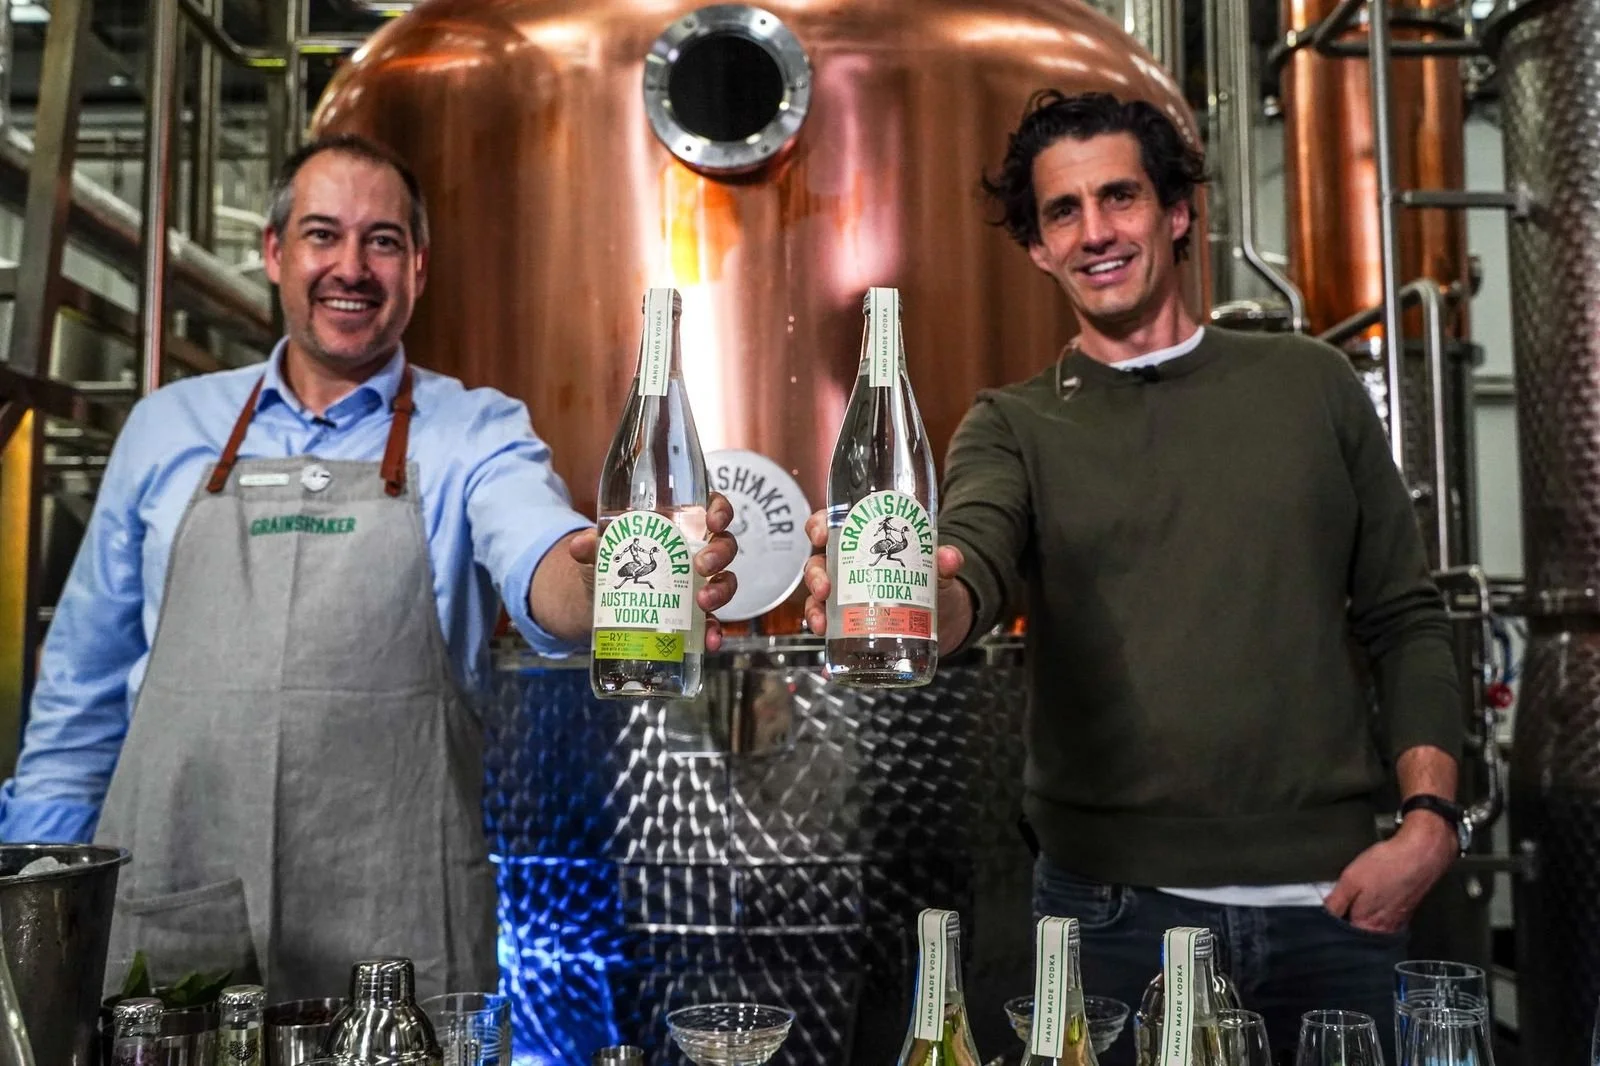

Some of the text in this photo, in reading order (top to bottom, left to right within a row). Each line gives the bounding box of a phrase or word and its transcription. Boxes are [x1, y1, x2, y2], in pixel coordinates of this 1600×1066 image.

[707, 466, 795, 535] SHAKER
[251, 514, 356, 536] GRAINSHAKER
[841, 494, 934, 556] GRAINSHAKER
[598, 515, 690, 575] GRAINSHAKER
[848, 568, 928, 587] AUSTRALIAN
[600, 592, 680, 609] AUSTRALIAN
[867, 584, 912, 600] VODKA
[614, 608, 659, 624] VODKA
[1045, 1017, 1053, 1043] HAND
